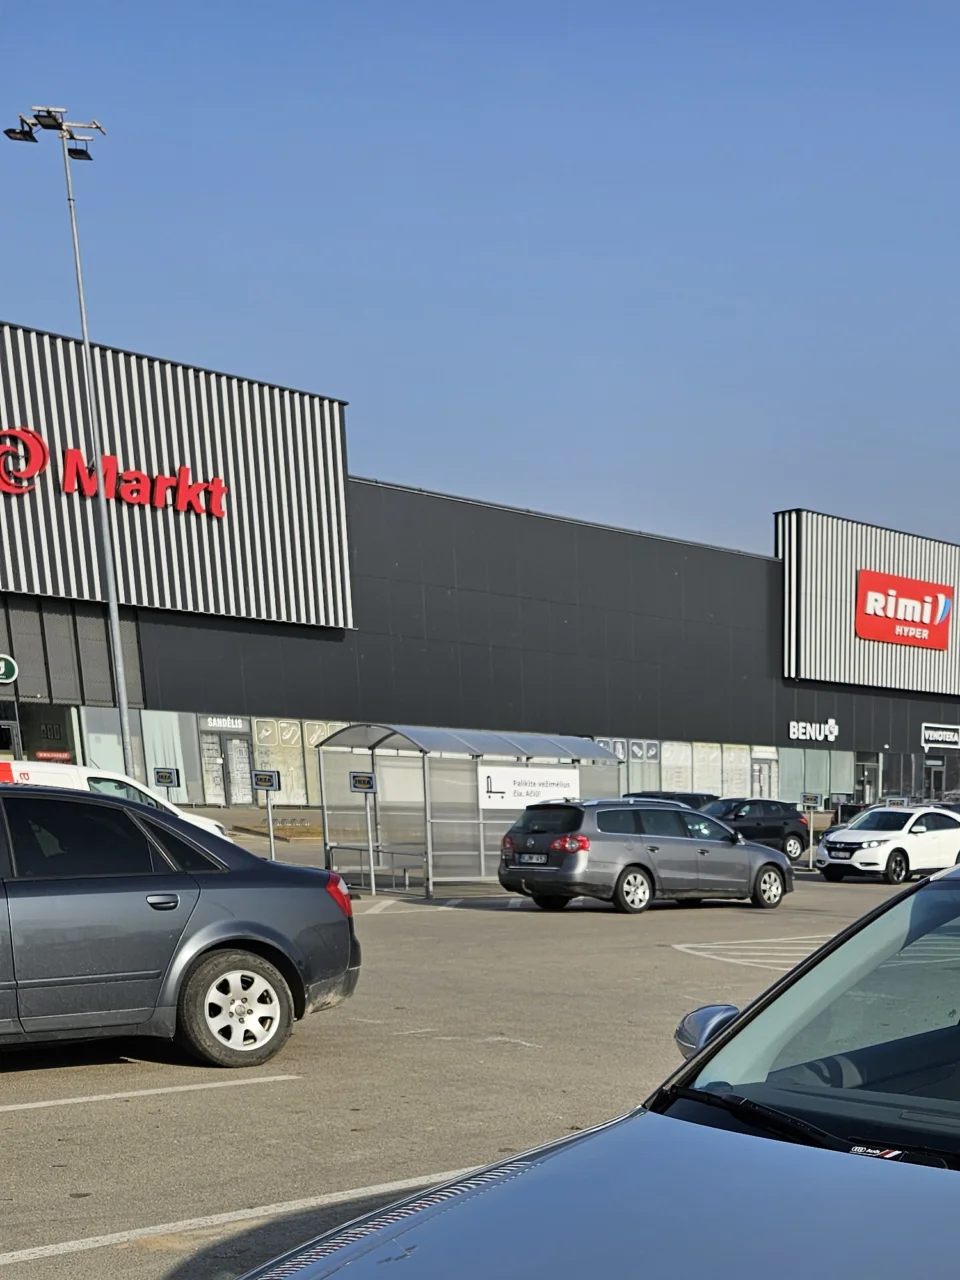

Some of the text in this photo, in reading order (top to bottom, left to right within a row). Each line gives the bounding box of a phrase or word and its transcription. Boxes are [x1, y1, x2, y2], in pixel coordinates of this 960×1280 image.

[62, 448, 228, 518] Markt
[864, 589, 932, 624] Rimi
[895, 625, 928, 639] HYPER
[789, 721, 825, 741] BENU
[256, 775, 273, 785] IKEA
[354, 778, 372, 788] IKEA
